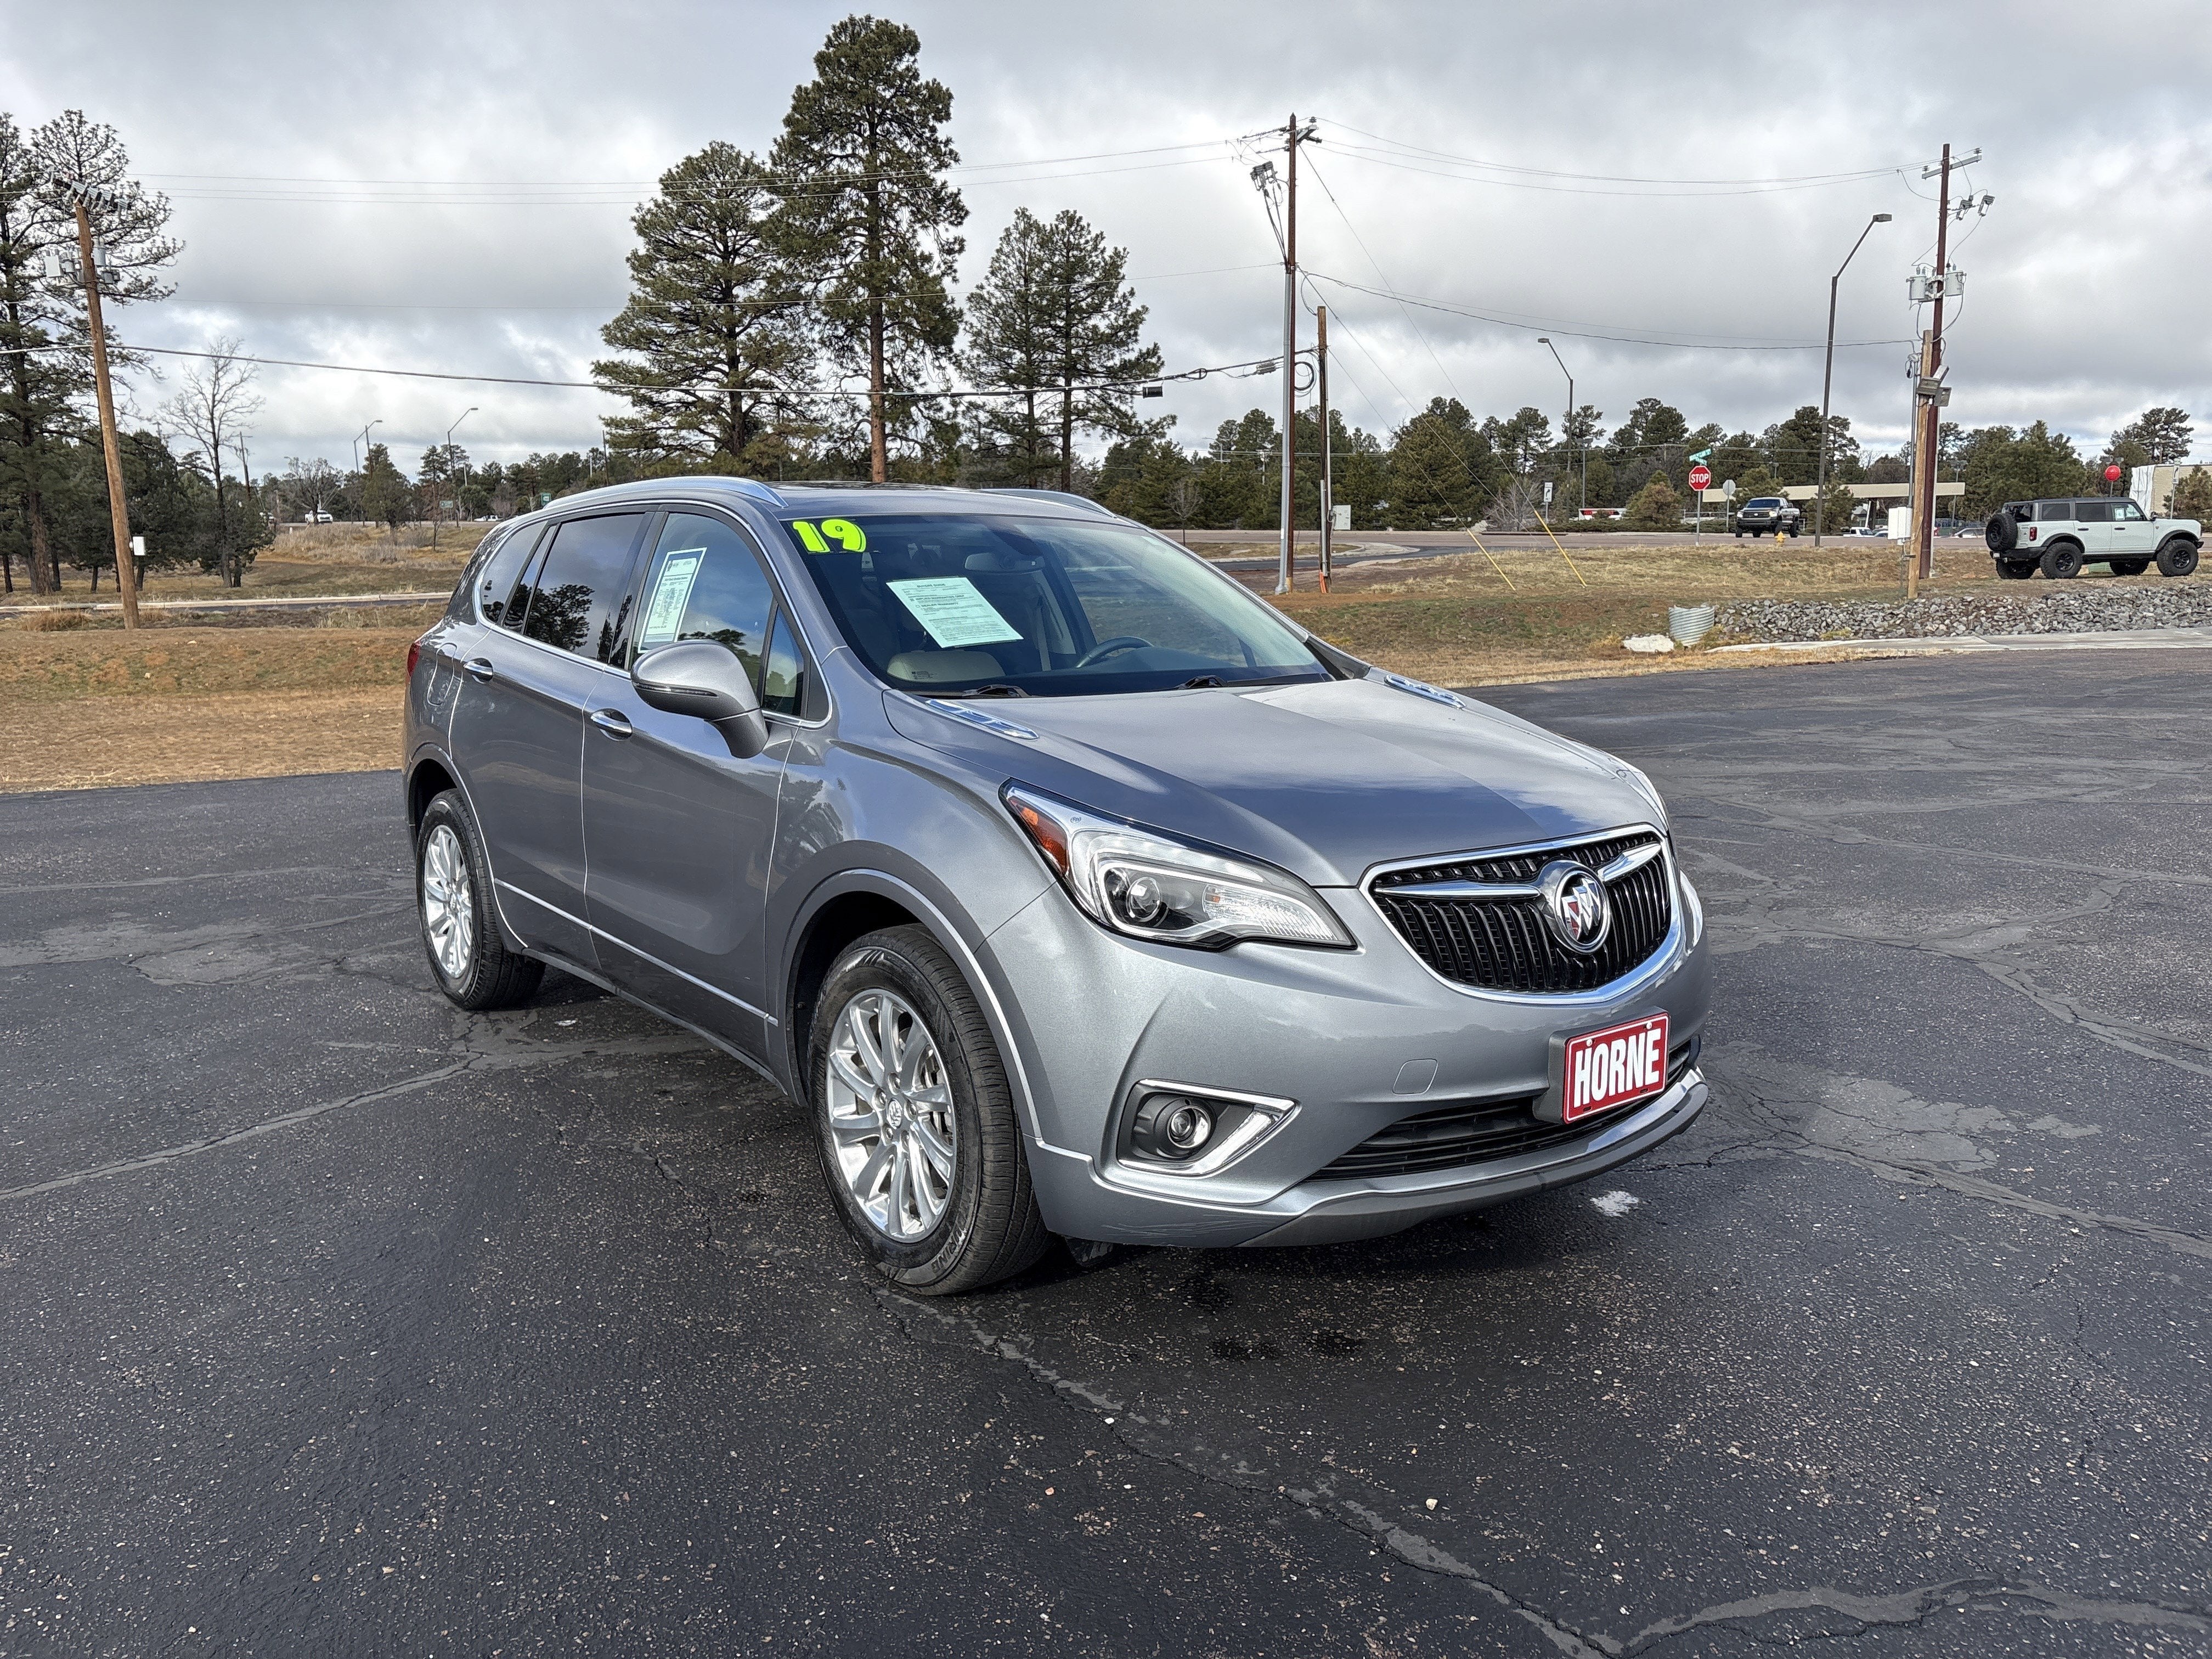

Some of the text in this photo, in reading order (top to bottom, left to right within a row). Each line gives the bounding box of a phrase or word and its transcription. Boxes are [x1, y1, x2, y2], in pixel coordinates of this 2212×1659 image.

[1690, 473, 1709, 483] STOP
[792, 519, 866, 553] 19
[1573, 1028, 1661, 1109] HORNE
